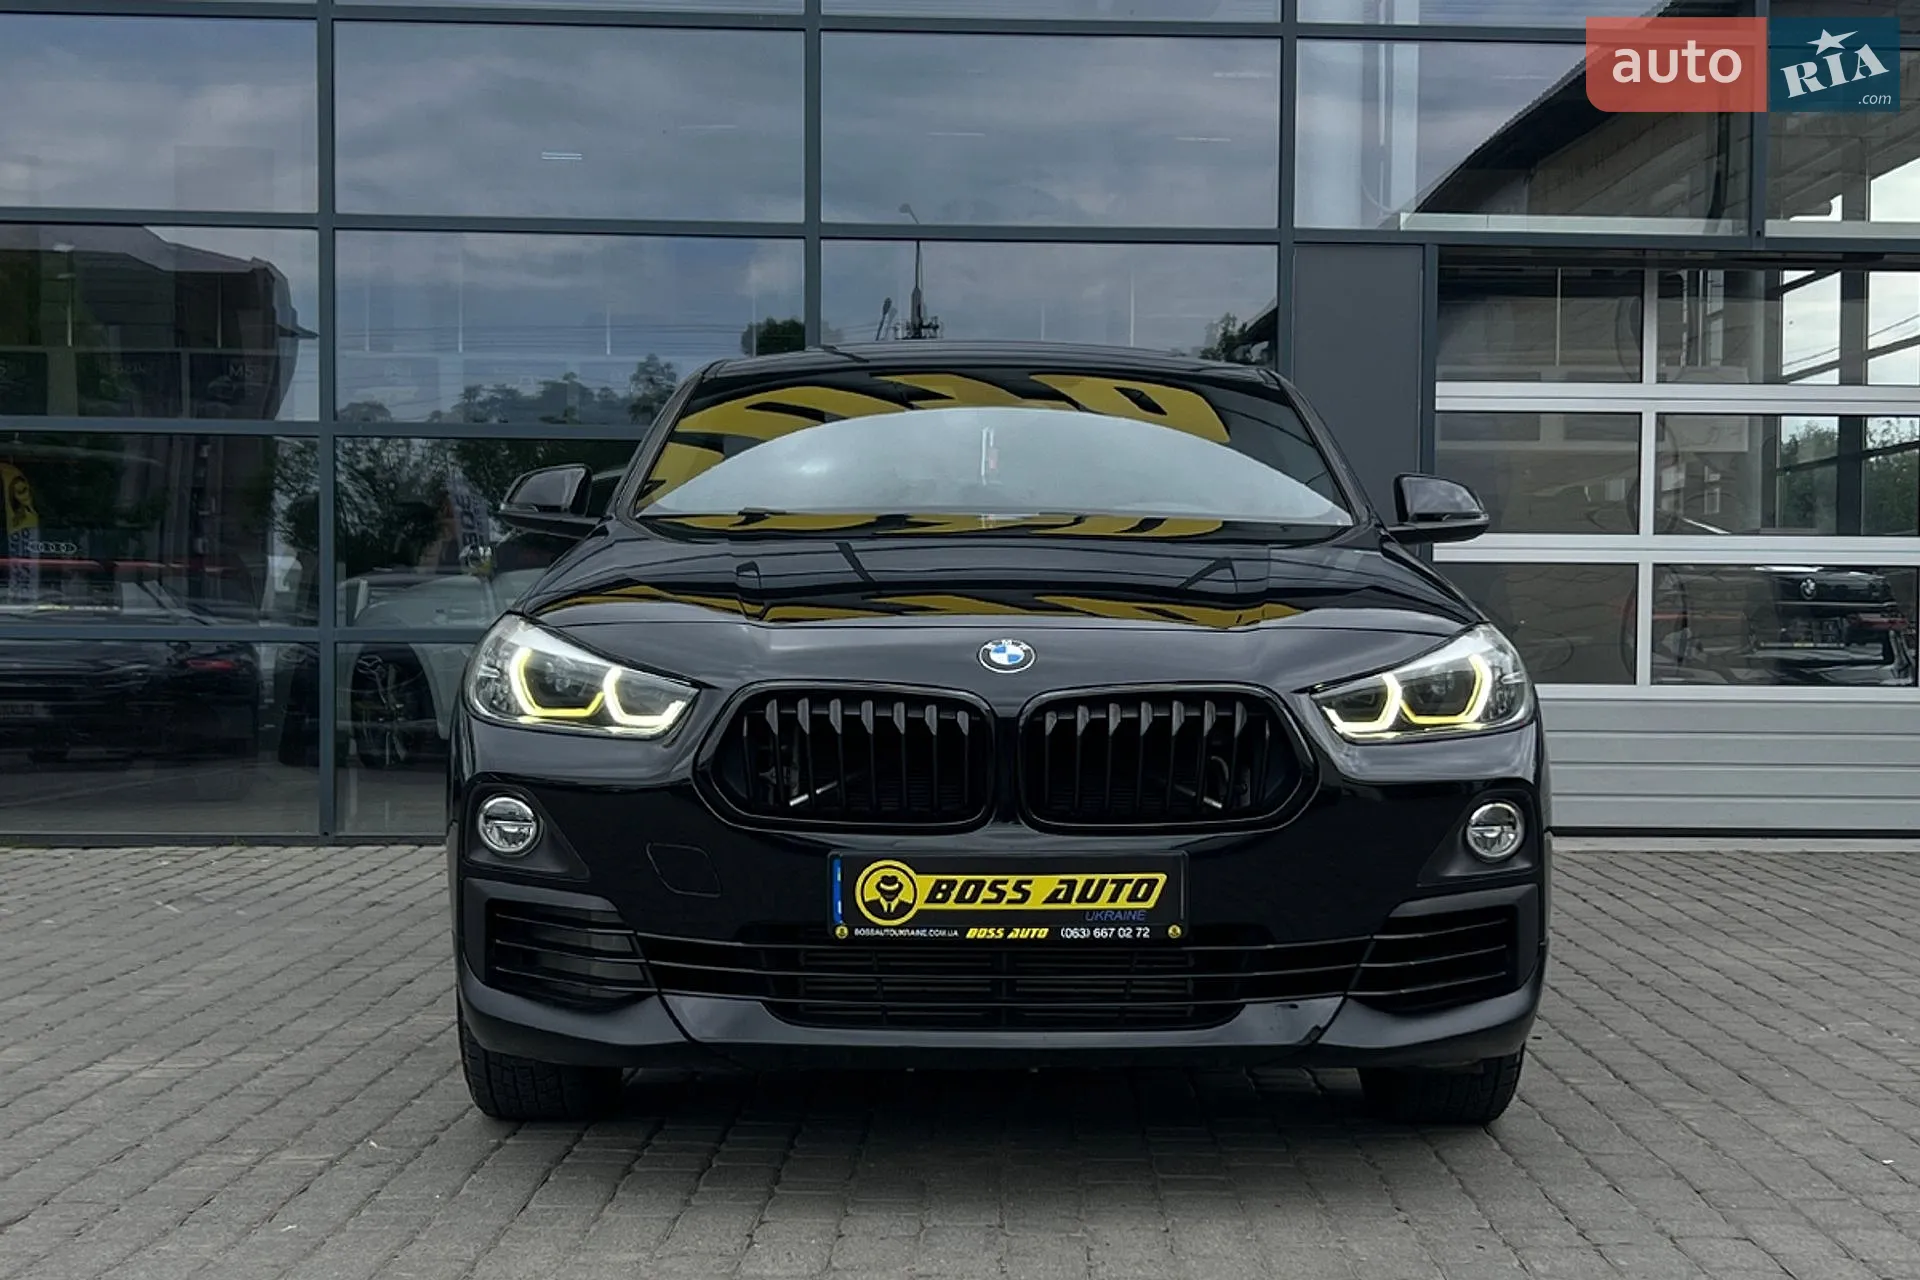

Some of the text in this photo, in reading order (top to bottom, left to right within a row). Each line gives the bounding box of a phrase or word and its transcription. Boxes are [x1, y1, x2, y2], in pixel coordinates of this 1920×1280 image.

[924, 878, 1160, 905] BOSS AUTO
[1085, 910, 1147, 921] UKRAINE
[966, 927, 1050, 939] BOSS AUTO
[1060, 926, 1151, 939] (063) 667 02 72
